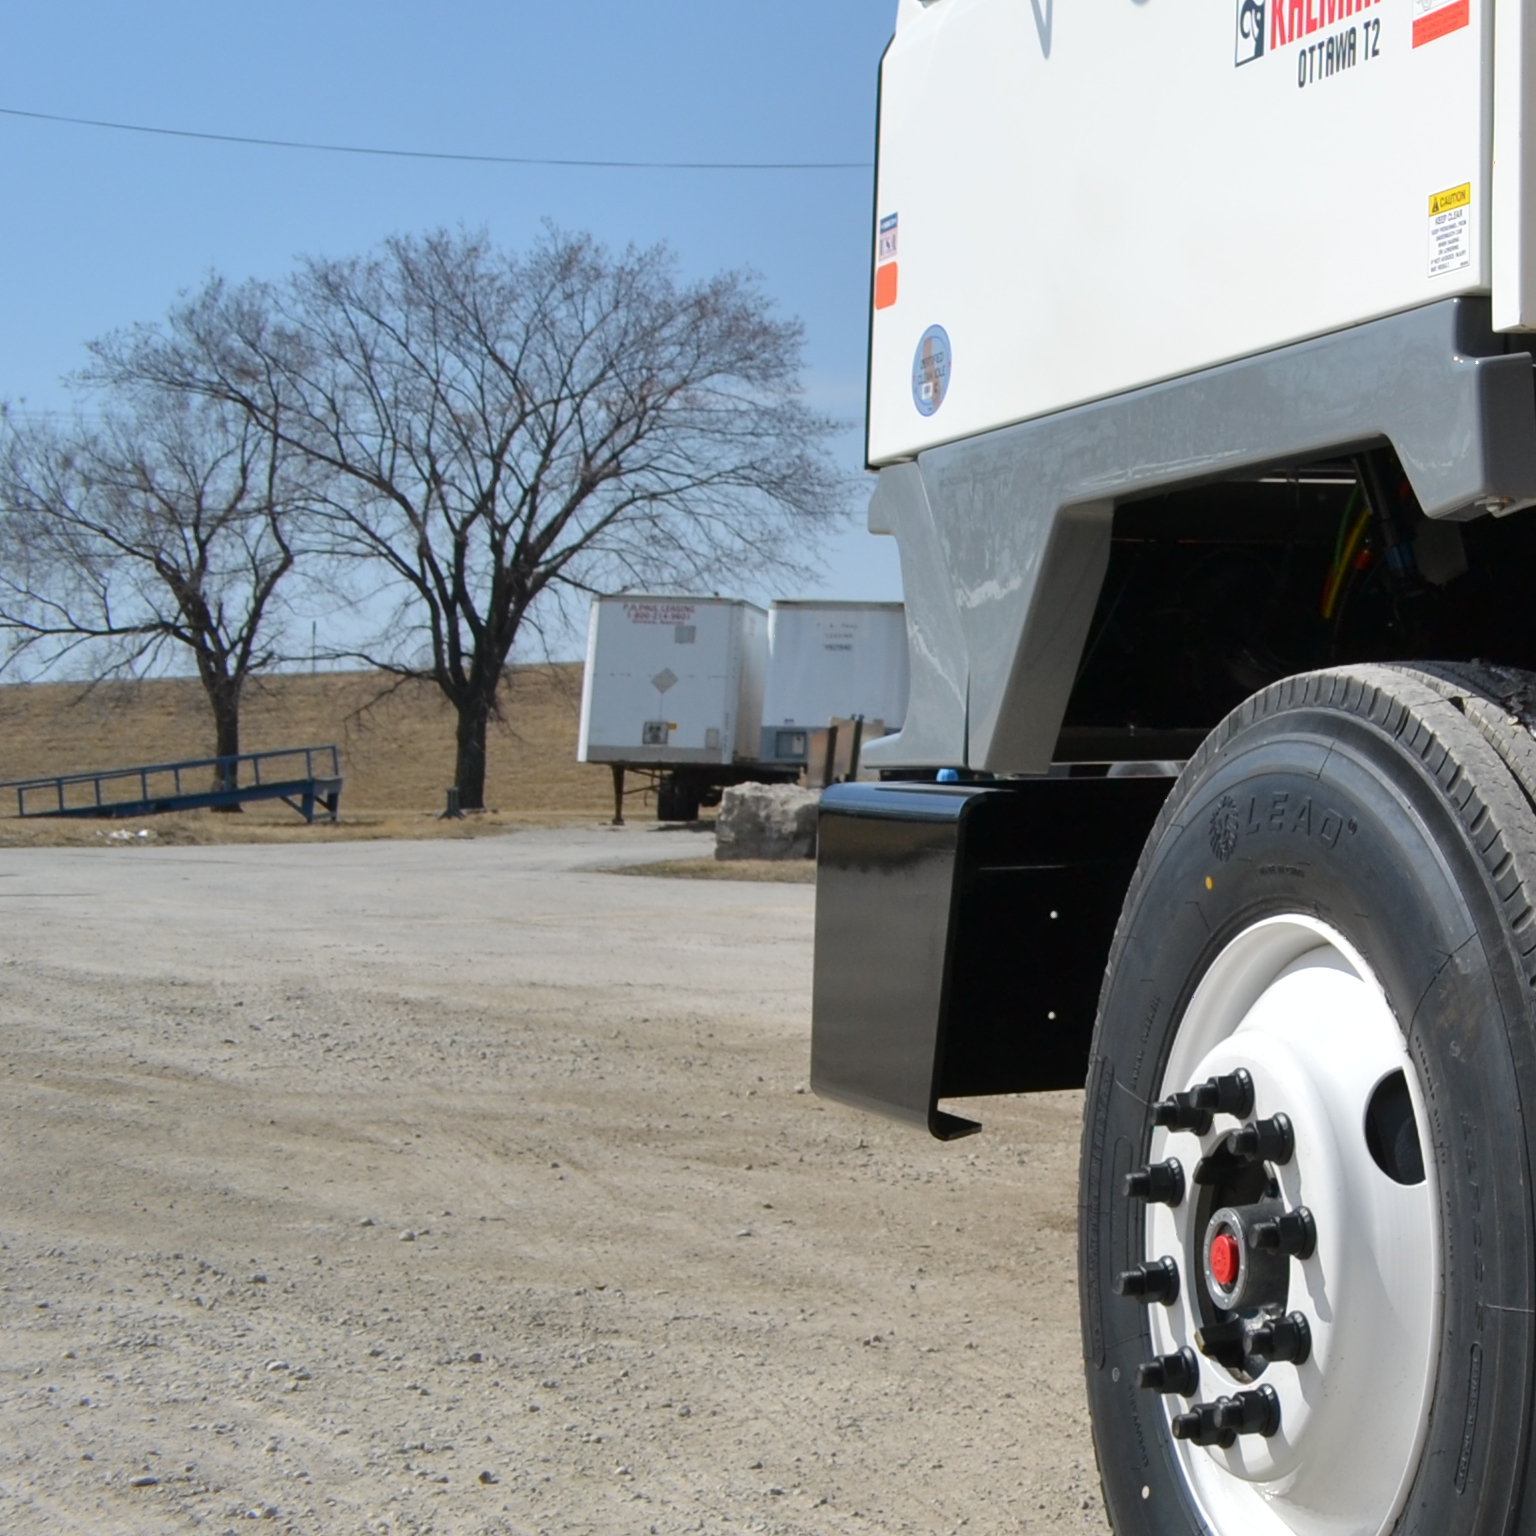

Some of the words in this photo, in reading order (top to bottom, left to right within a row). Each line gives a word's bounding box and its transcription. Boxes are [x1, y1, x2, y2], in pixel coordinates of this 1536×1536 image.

[1297, 26, 1356, 89] OTTAWA
[1363, 17, 1381, 62] T2
[1440, 190, 1466, 207] CAUTION
